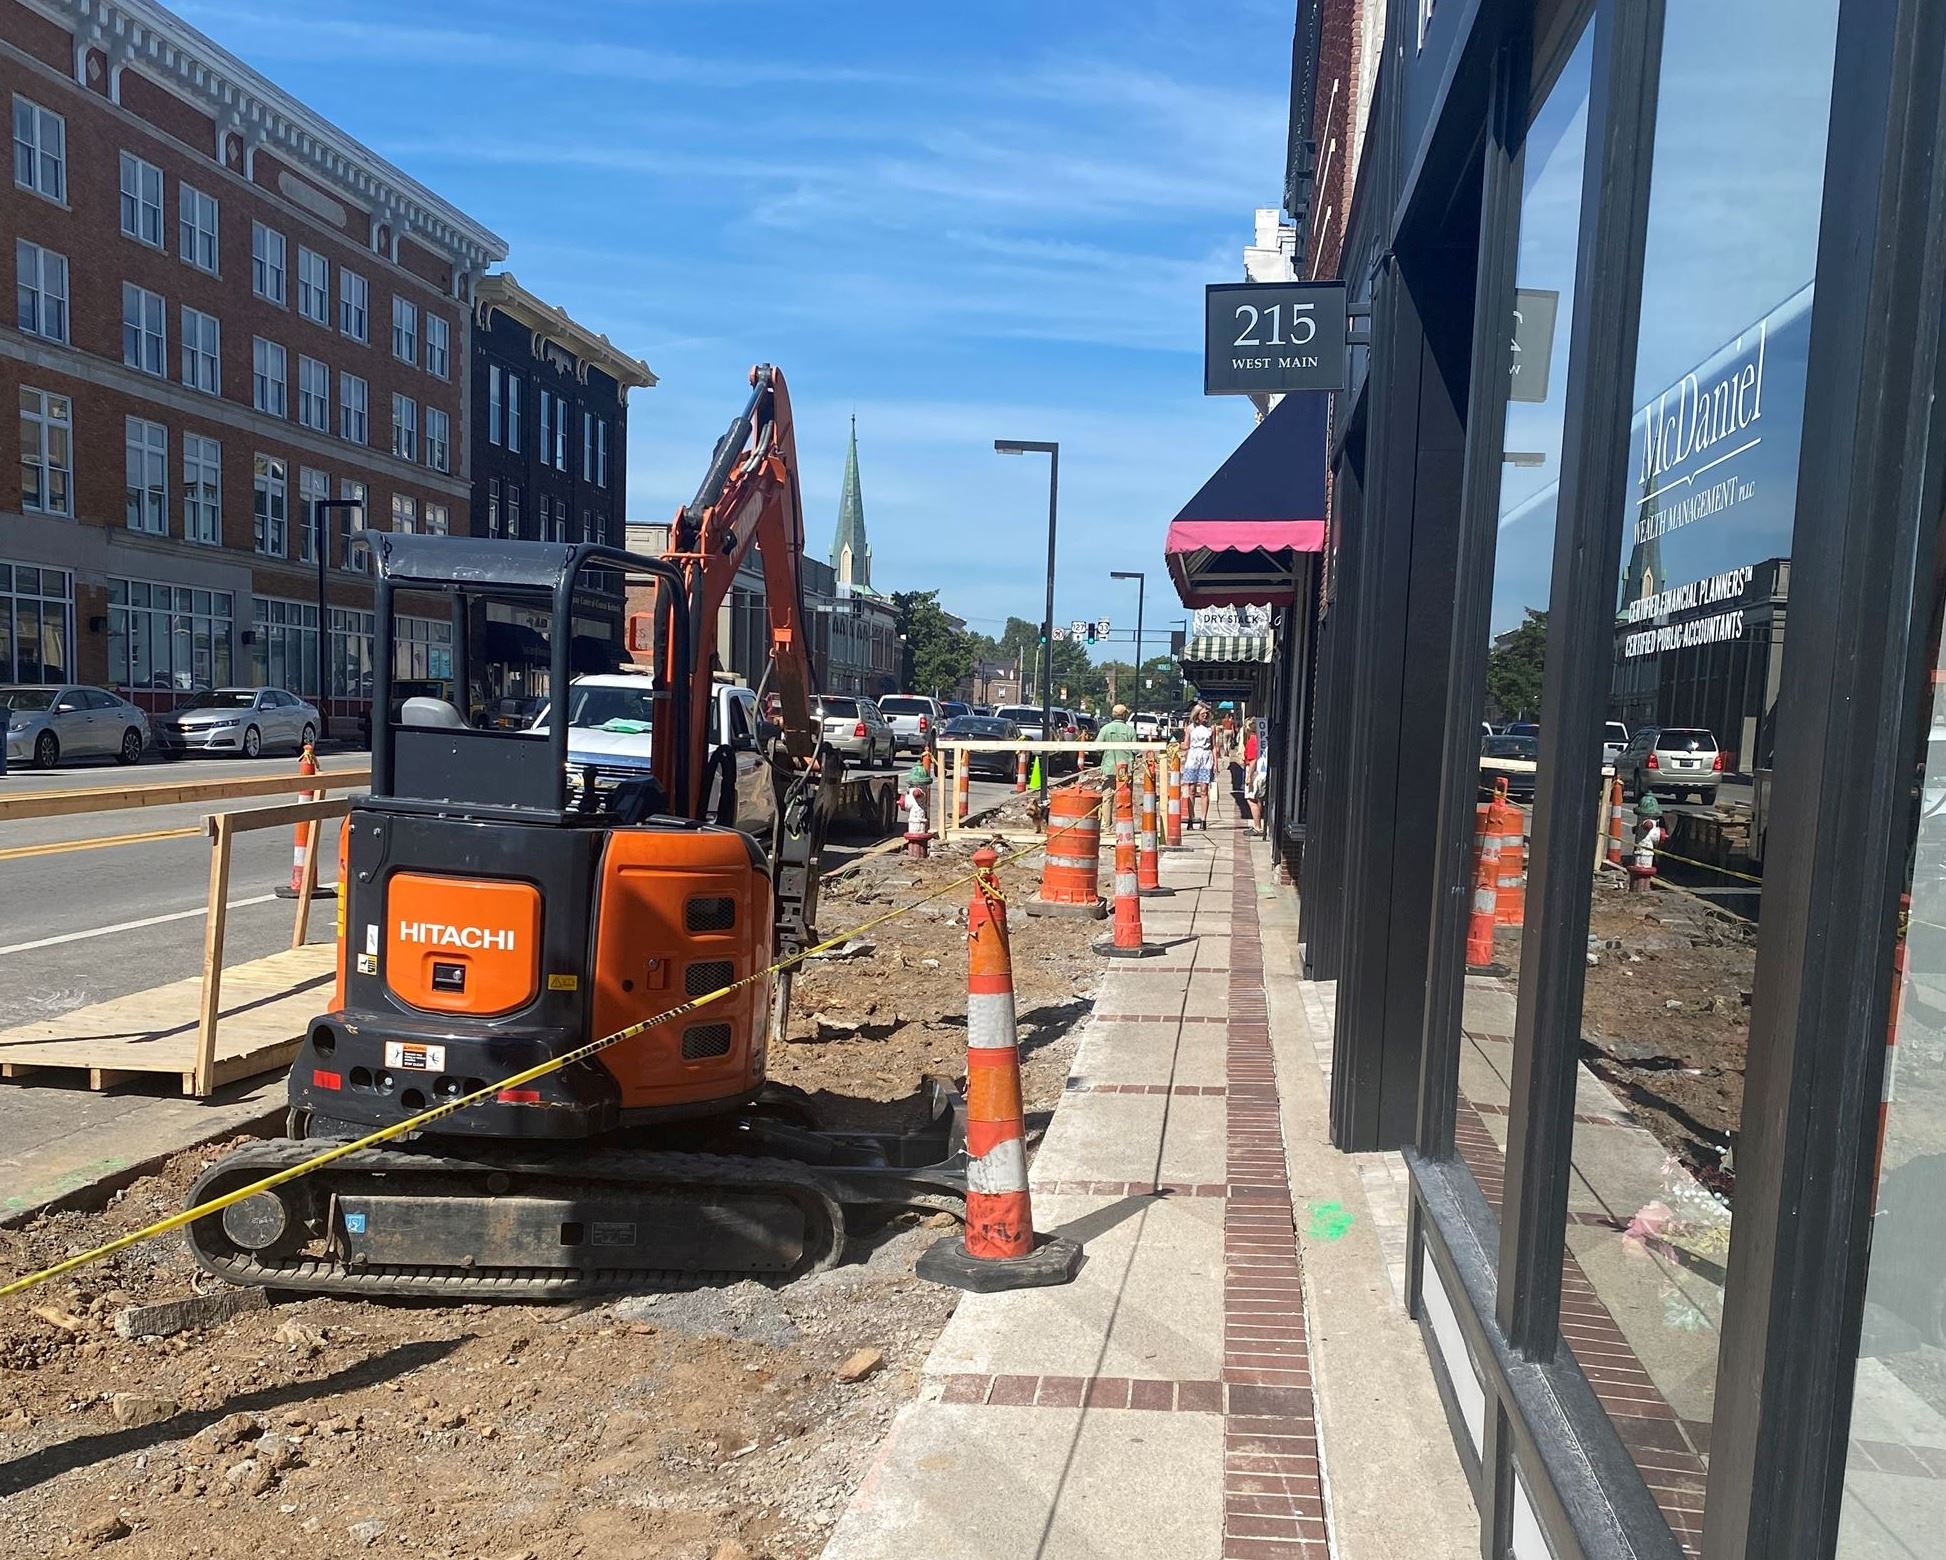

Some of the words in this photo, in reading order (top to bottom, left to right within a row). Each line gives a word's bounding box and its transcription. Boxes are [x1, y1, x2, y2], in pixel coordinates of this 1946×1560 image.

[1233, 303, 1316, 346] 215
[1232, 357, 1271, 369] WEST
[1278, 356, 1319, 368] MAIN
[1638, 318, 1767, 485] McDaniel
[1634, 509, 1666, 545] WEALTH
[1667, 475, 1738, 532] MANAGEMENT
[1738, 480, 1755, 502] PLLC
[1203, 614, 1224, 624] DRY
[1227, 614, 1259, 624] STACK
[1628, 593, 1660, 624] CERTIFIED
[1659, 582, 1697, 616] FINANCIAL
[1073, 623, 1085, 631] 127
[1625, 630, 1657, 658] CERTIFIED
[1656, 624, 1682, 652] PUBLIC
[1682, 609, 1744, 648] ACCOUNTANTS
[399, 920, 515, 951] HITACHI
